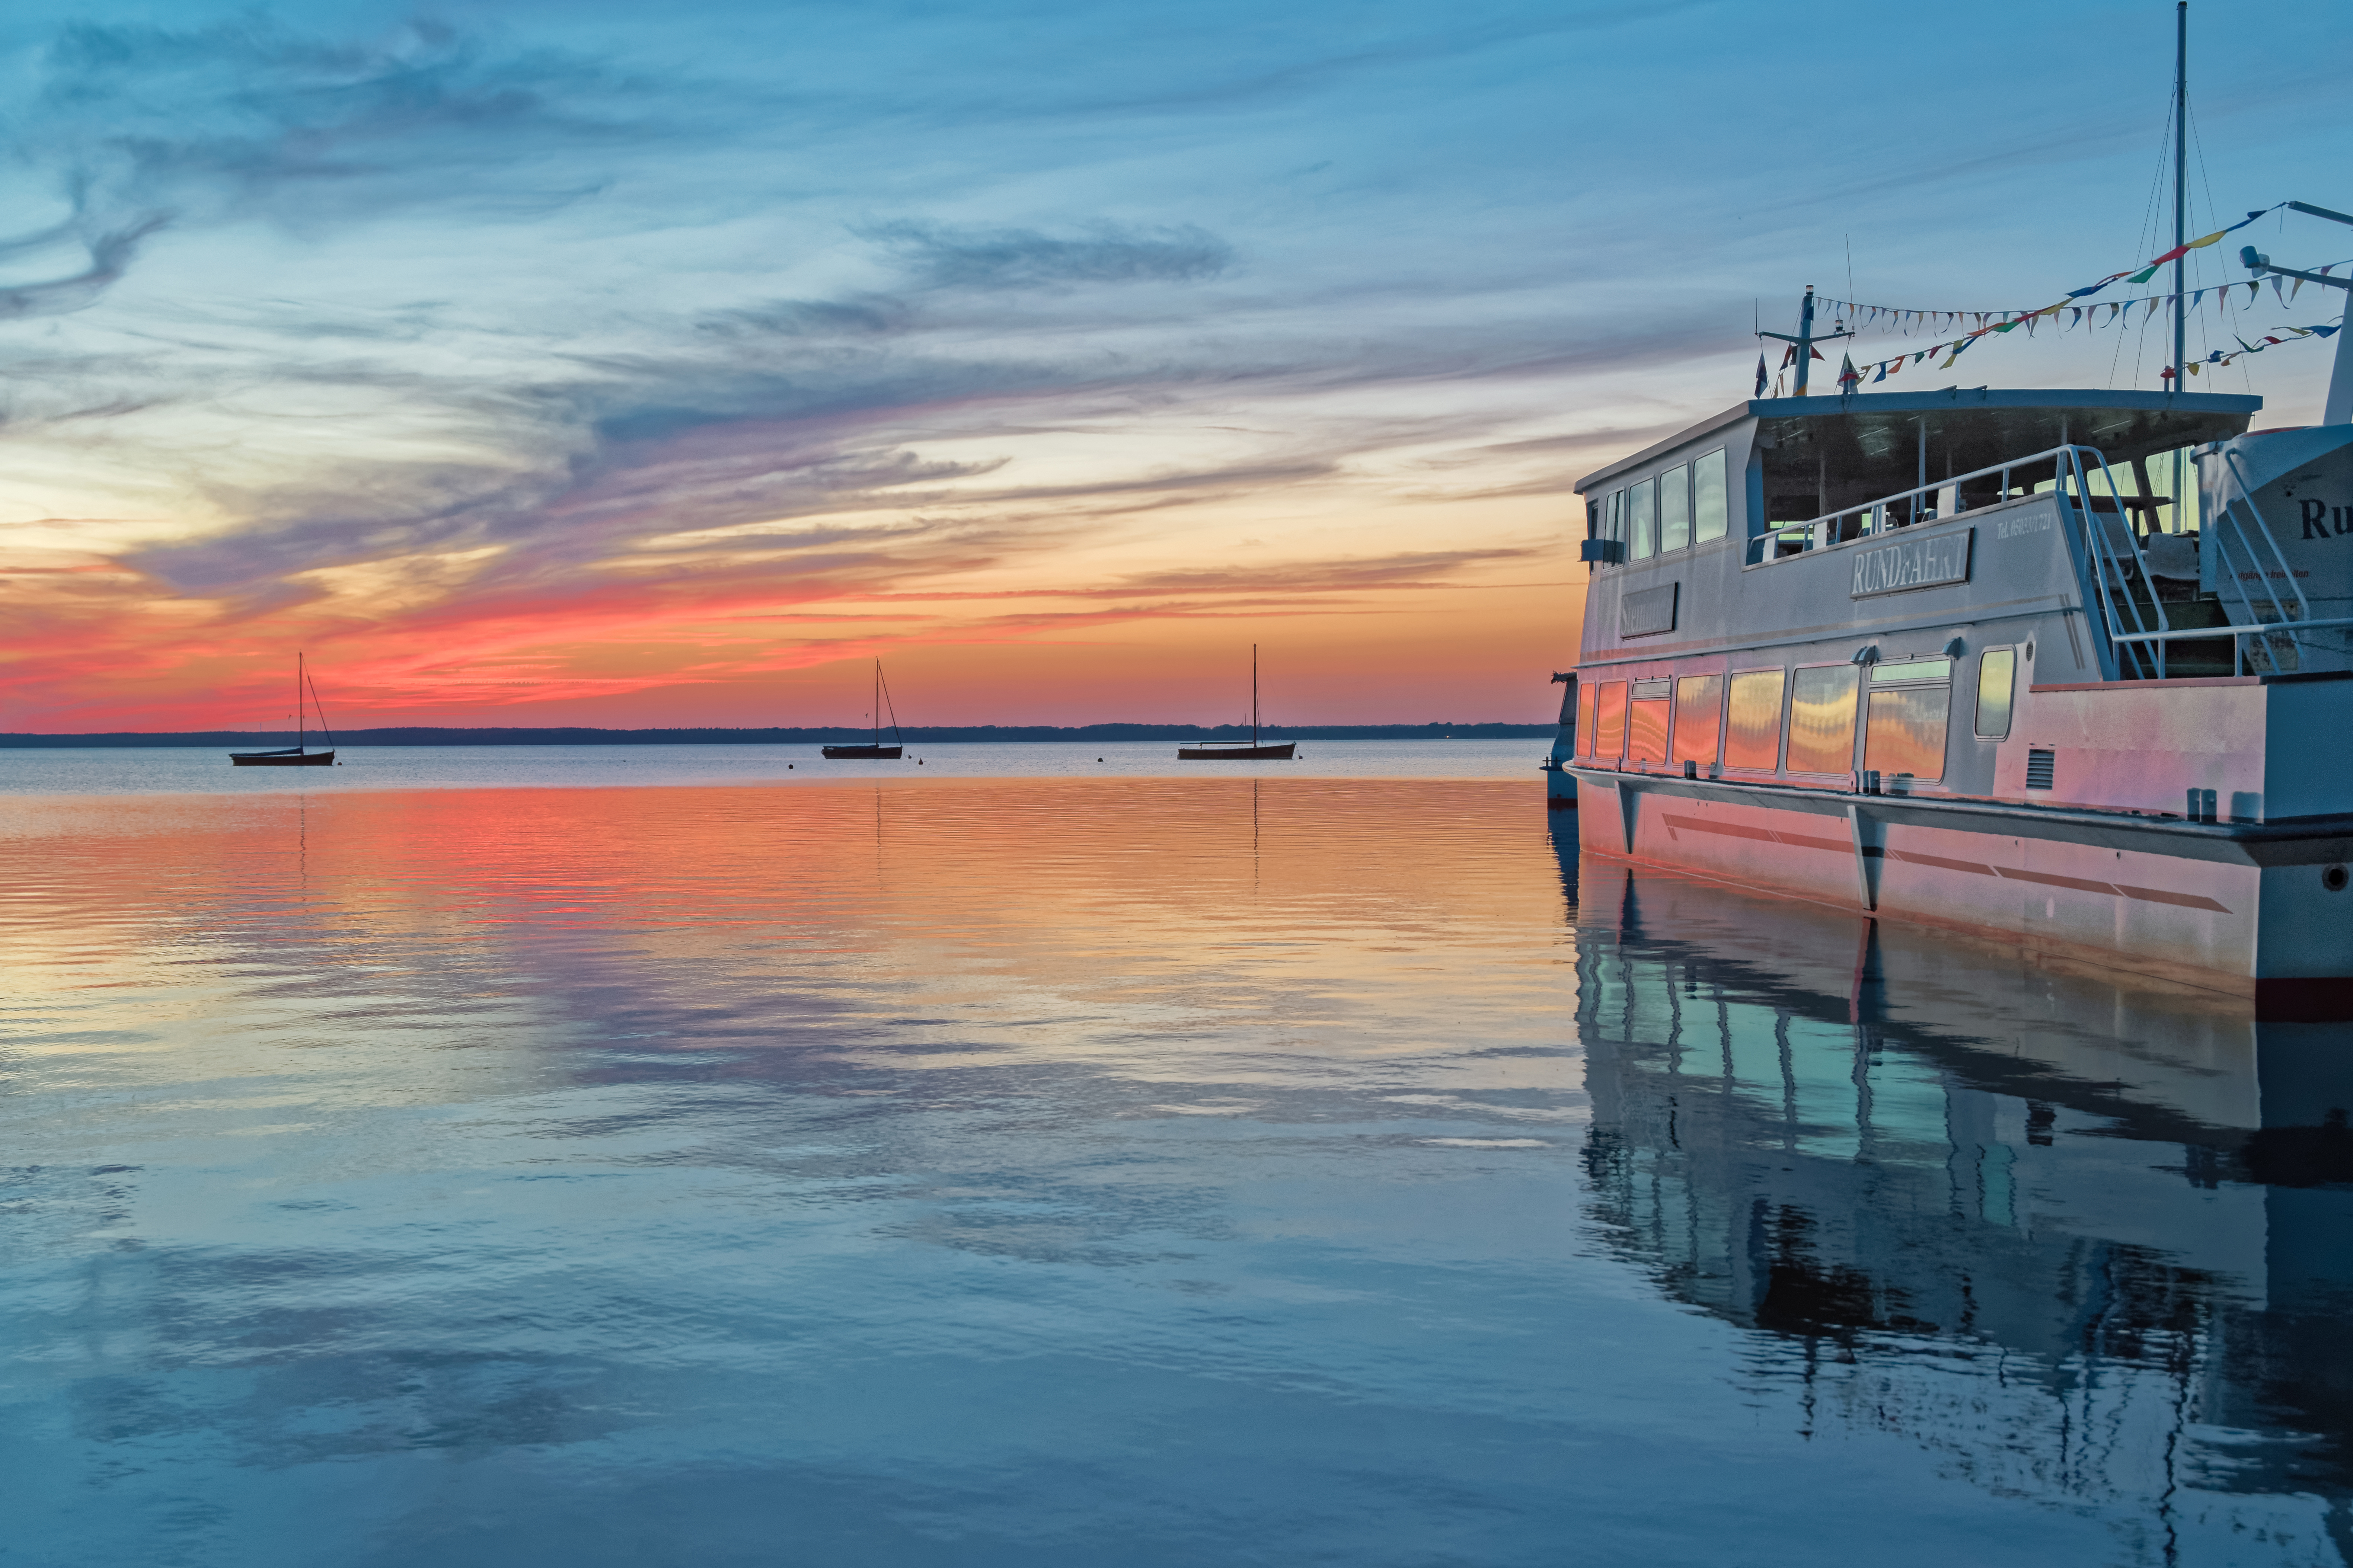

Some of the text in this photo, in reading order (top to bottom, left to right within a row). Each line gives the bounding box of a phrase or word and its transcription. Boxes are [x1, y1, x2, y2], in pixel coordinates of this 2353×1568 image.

[1998, 522, 2008, 539] Tel.
[2298, 499, 2353, 540] Ru
[1851, 533, 1967, 594] RUNDFAHRT
